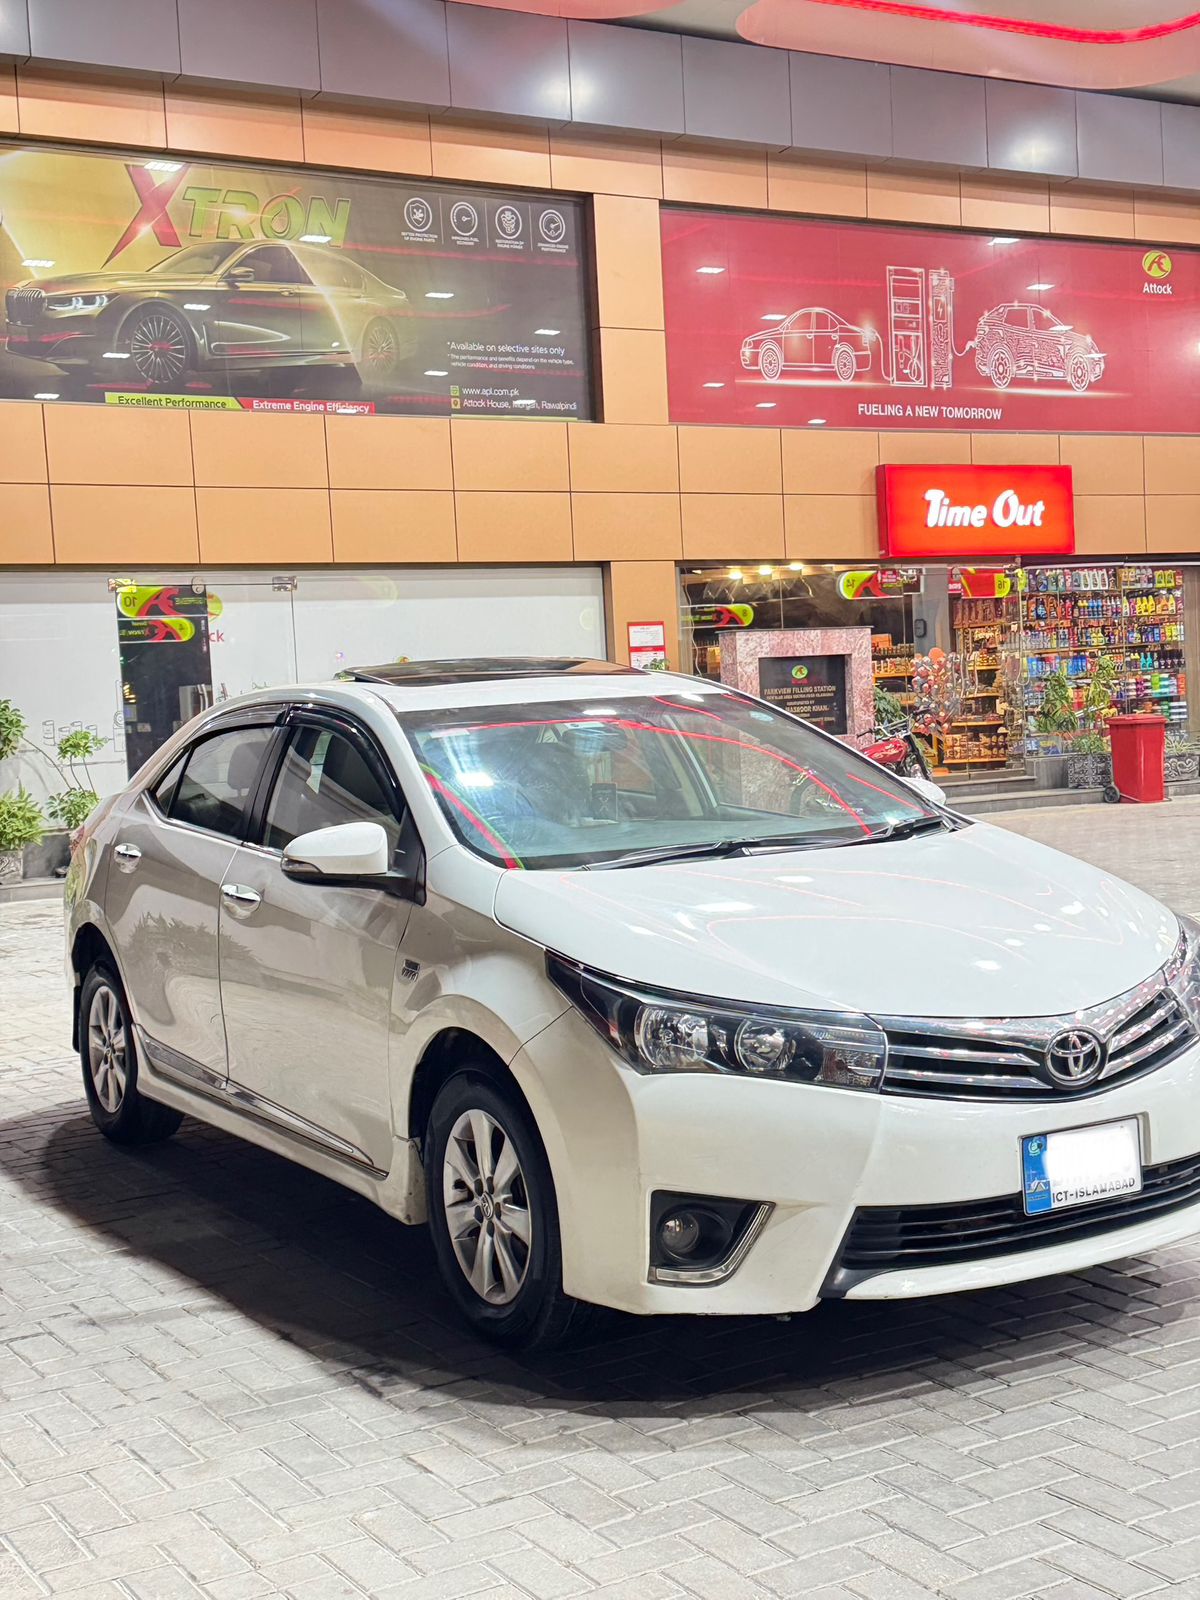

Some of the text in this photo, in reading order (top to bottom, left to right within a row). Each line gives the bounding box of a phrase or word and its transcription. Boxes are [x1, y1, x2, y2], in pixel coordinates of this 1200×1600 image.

[101, 164, 350, 268] XTRON
[1143, 282, 1172, 294] Attock
[498, 344, 530, 353] selective
[531, 345, 548, 354] sites
[550, 346, 565, 357] only
[462, 387, 519, 397] www.apl.com.pk
[118, 396, 227, 409] Excellent Performance
[253, 400, 291, 411] Extreme
[293, 402, 324, 413] Engine
[463, 399, 485, 408] Attock
[542, 401, 577, 411] Rawalpindi
[858, 403, 1002, 420] FUELING A NEW TOMORROW
[924, 489, 1045, 528] Time Out
[1052, 1177, 1136, 1204] ICT-ISLAMABAD
